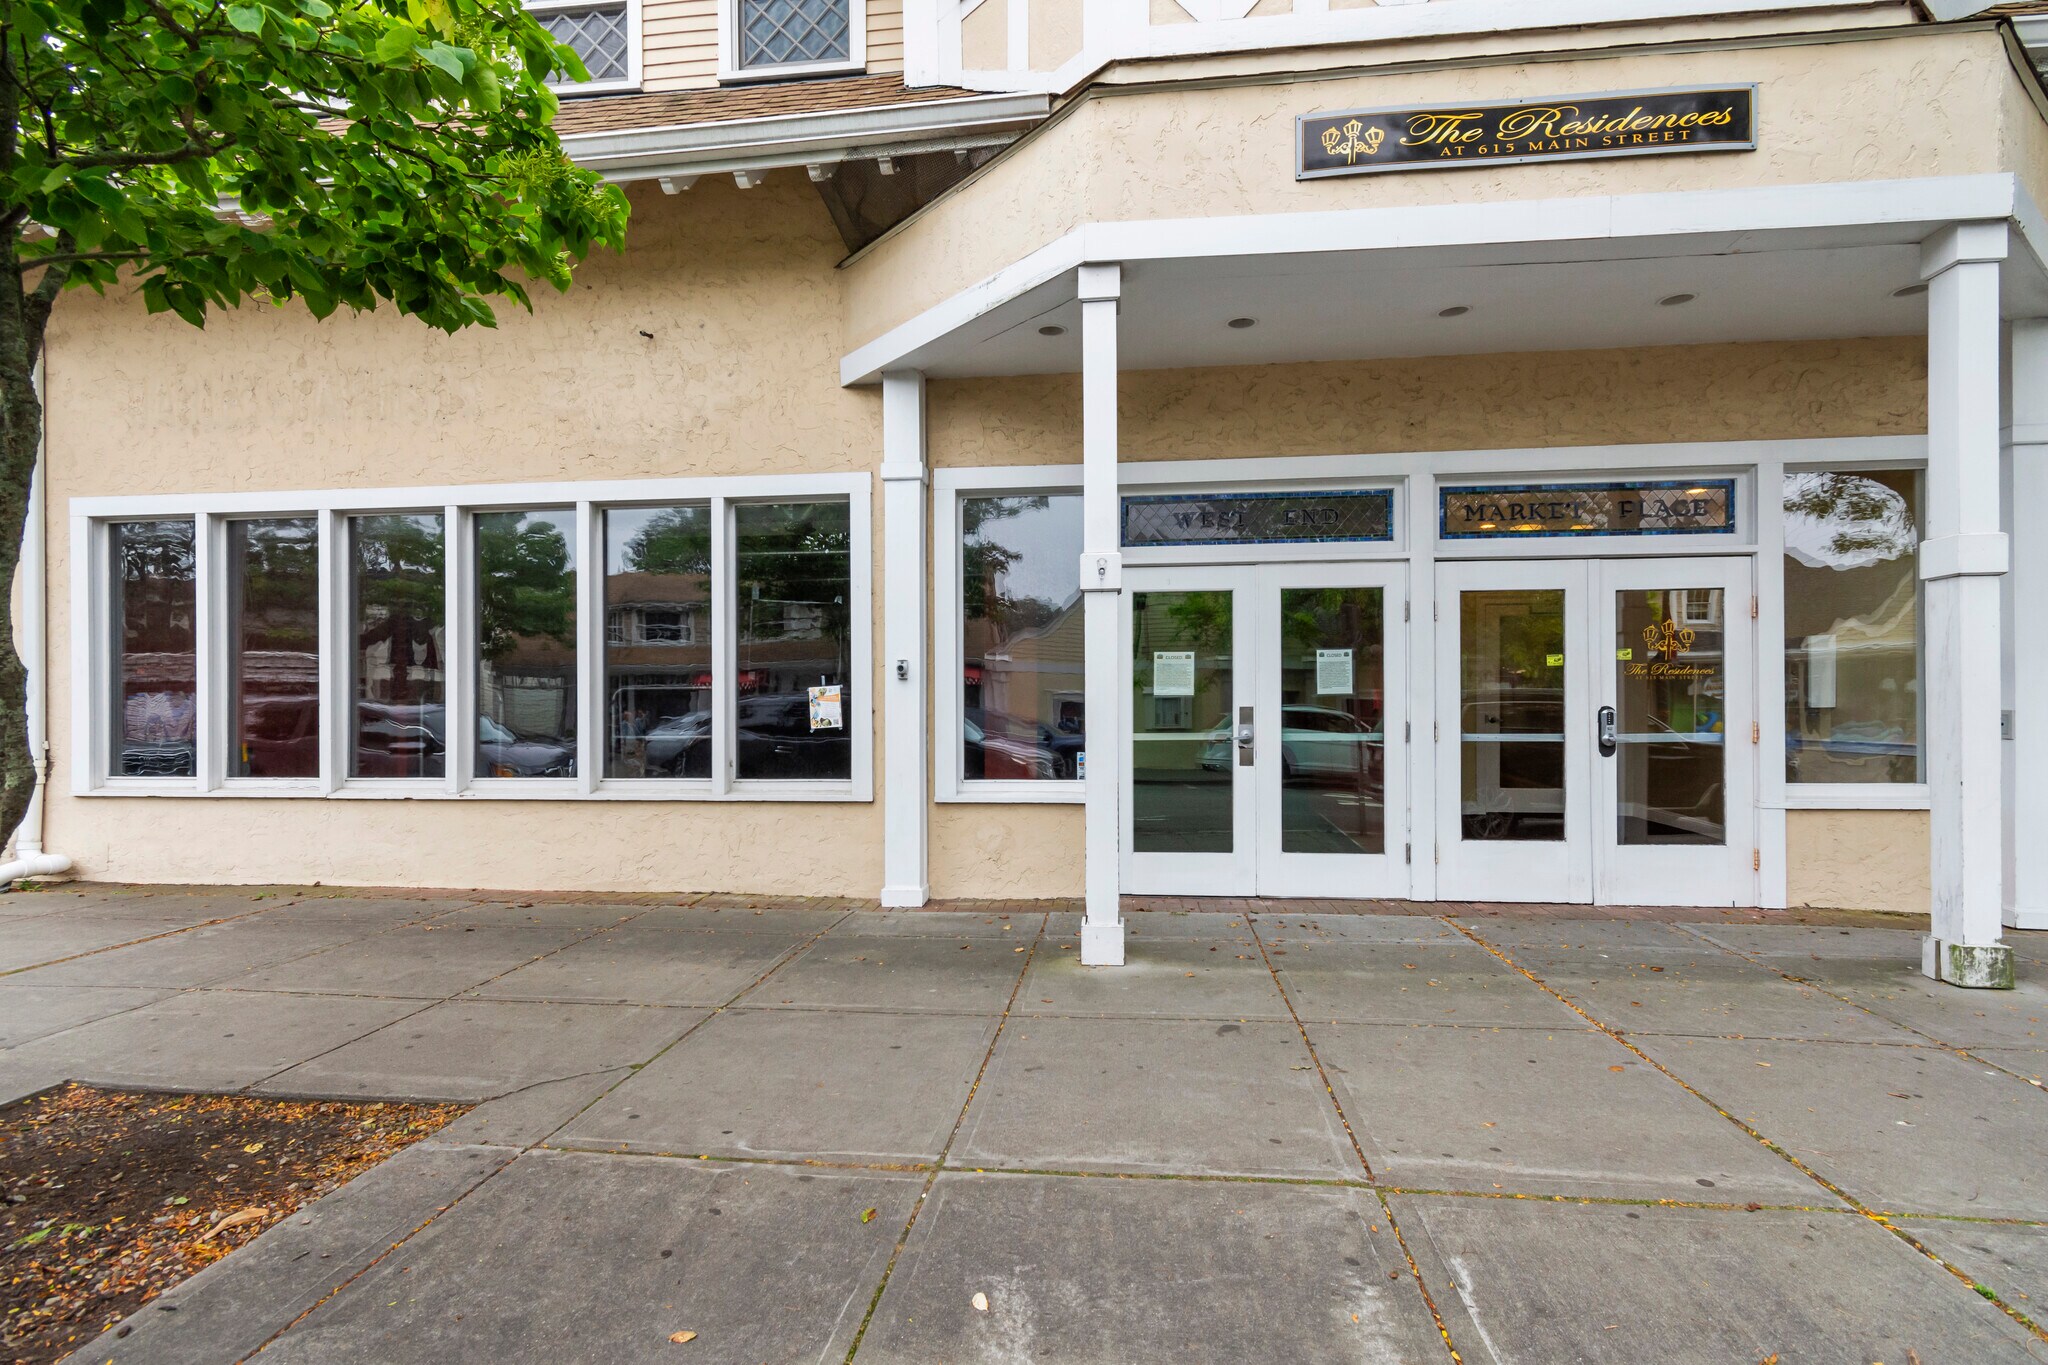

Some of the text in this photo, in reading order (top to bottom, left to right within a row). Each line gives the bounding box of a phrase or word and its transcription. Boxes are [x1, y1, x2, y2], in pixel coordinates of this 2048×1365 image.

[1400, 105, 1732, 146] The Residences
[1439, 130, 1691, 156] AT 615 MAIN STREET
[1172, 510, 1246, 530] WEST
[1282, 508, 1339, 526] END
[1463, 499, 1587, 522] MARKET
[1624, 662, 1715, 675] The Residences
